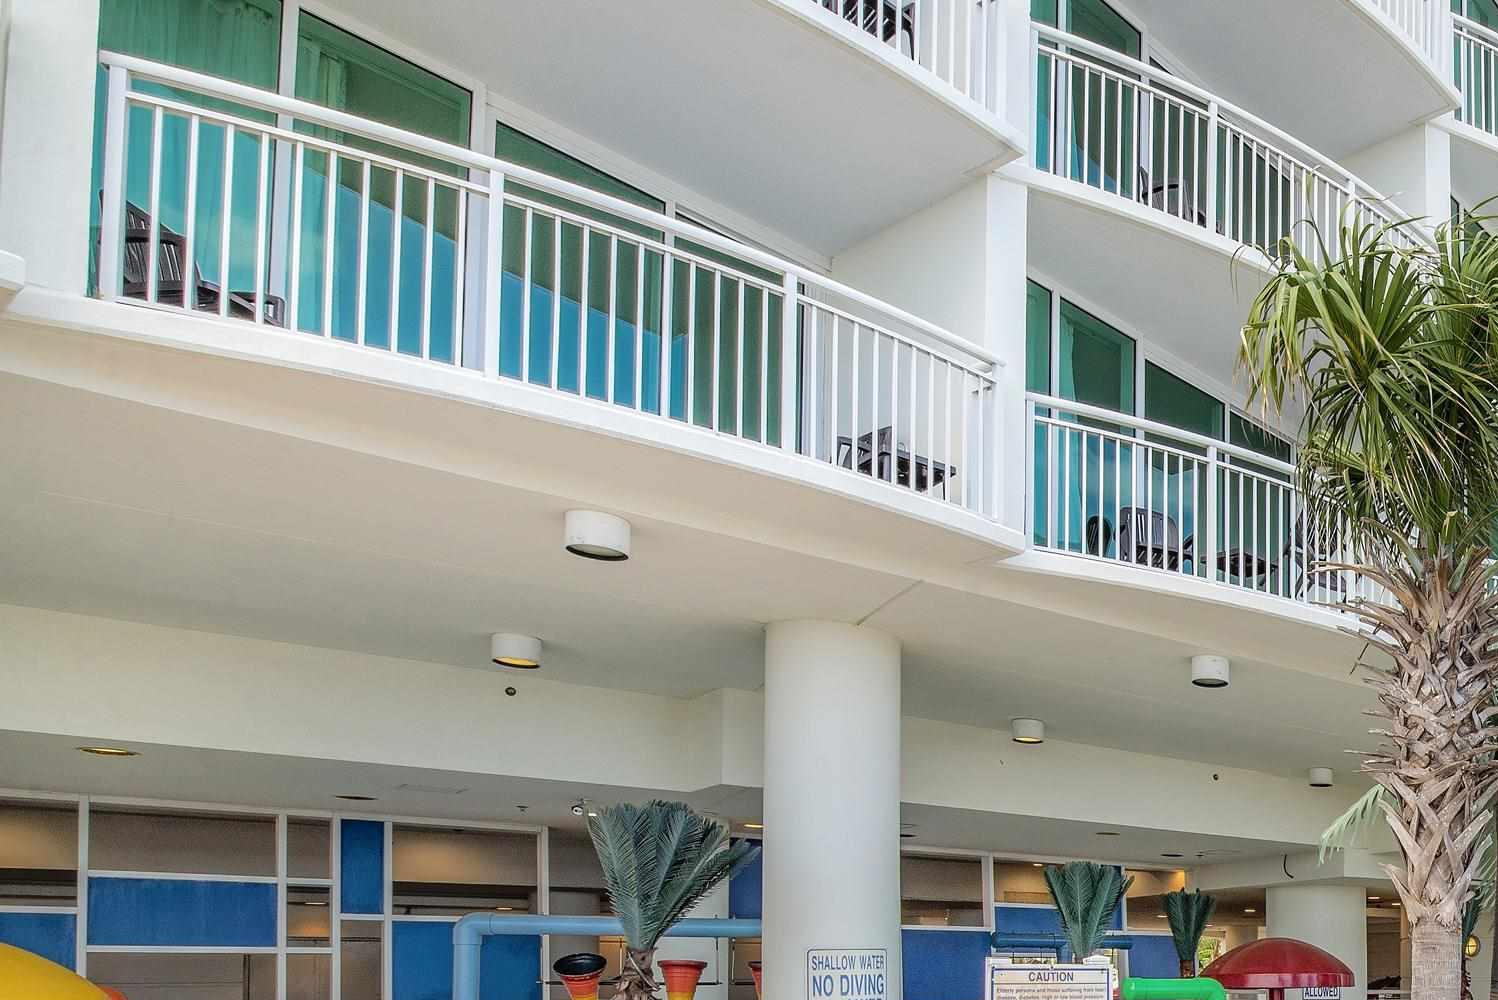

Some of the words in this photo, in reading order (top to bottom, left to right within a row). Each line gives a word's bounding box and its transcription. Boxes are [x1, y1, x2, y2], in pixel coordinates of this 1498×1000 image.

[811, 955, 856, 971] SHALLOW
[860, 955, 884, 970] WATER
[1028, 971, 1074, 982] CAUTION
[812, 974, 834, 997] NO
[840, 973, 884, 996] DIVING
[1304, 987, 1338, 998] ALLOWED
